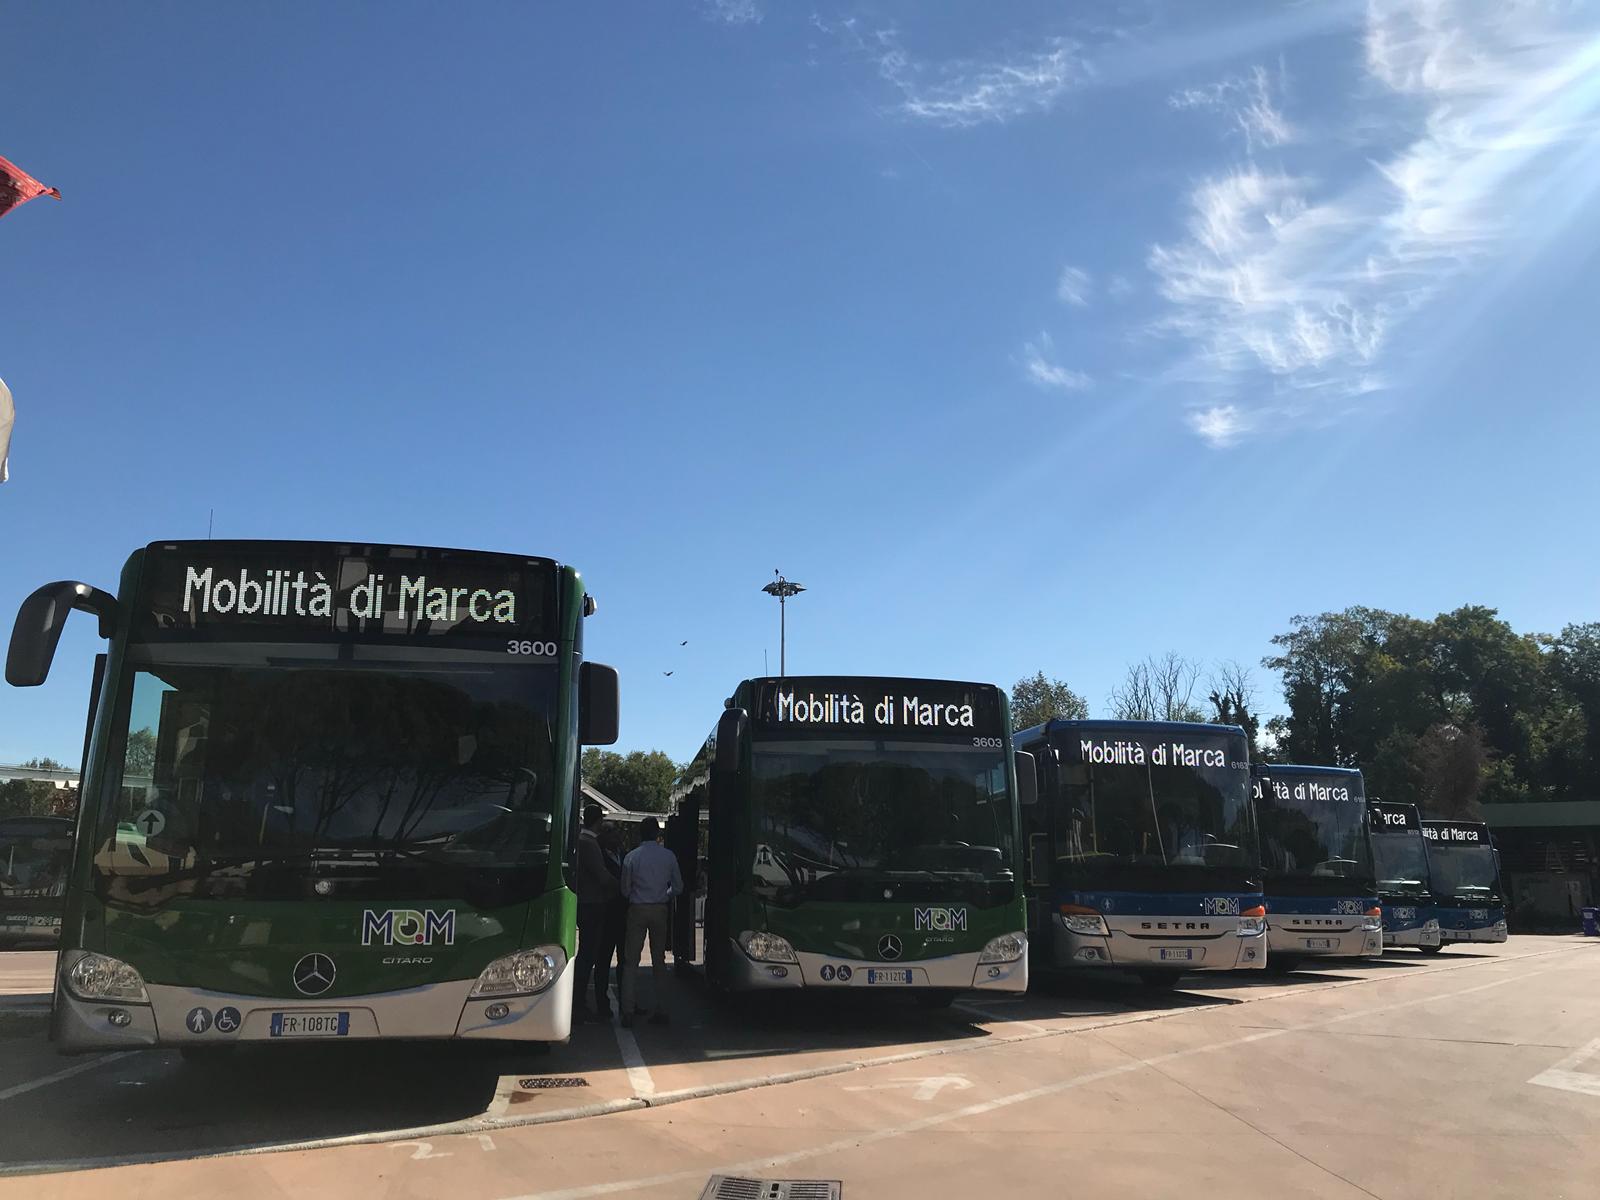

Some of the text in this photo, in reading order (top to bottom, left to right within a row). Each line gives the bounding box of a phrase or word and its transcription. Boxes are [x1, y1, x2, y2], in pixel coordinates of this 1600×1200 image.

[183, 566, 516, 623] Mobilità di Marca
[507, 640, 557, 656] 3600
[778, 692, 974, 727] Mobilità di Marca
[972, 737, 1003, 748] 3603
[1080, 740, 1226, 768] Mobilità di Marca
[1294, 783, 1306, 800] di
[1309, 783, 1349, 801] Marca
[1440, 828, 1449, 840] di
[1451, 828, 1479, 840] Marca
[1204, 898, 1240, 915] MOM
[362, 909, 456, 945] MOM
[914, 907, 967, 930] MOM
[1141, 922, 1210, 930] SETRA
